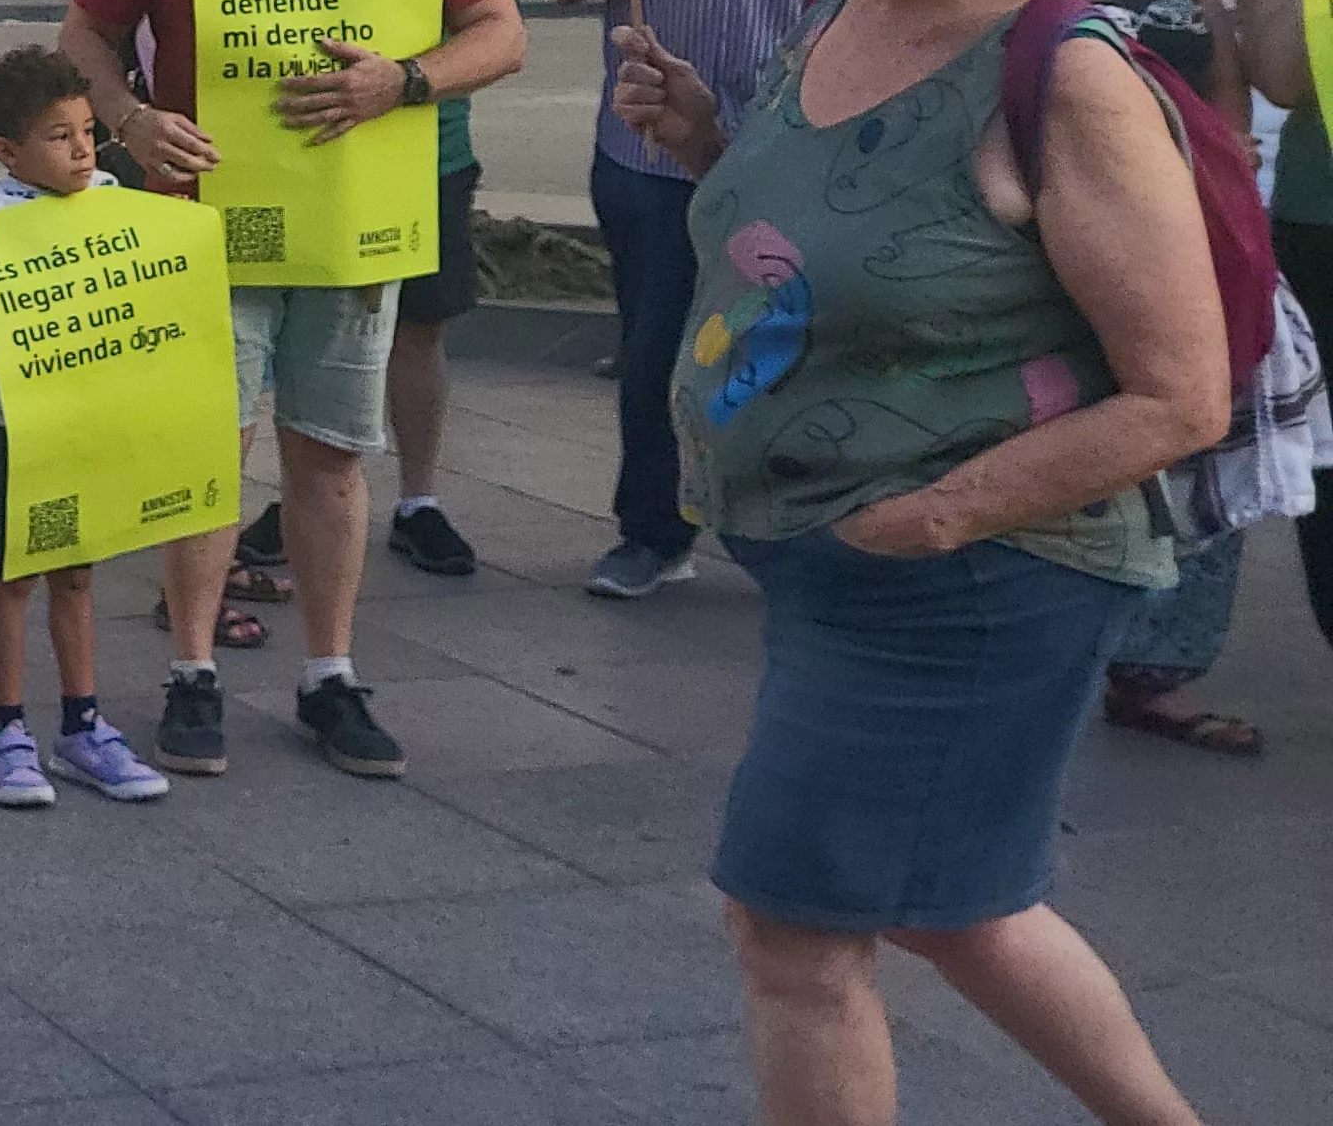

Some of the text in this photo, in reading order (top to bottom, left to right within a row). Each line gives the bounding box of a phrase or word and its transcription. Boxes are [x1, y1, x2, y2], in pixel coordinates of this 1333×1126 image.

[223, 19, 373, 48] mi derecho
[223, 61, 238, 79] a
[248, 57, 271, 79] la
[24, 244, 80, 274] más
[84, 227, 140, 258] fácil
[0, 254, 188, 314] llegar a la luna
[12, 301, 135, 351] que a una
[19, 322, 186, 379] vivienda digna.
